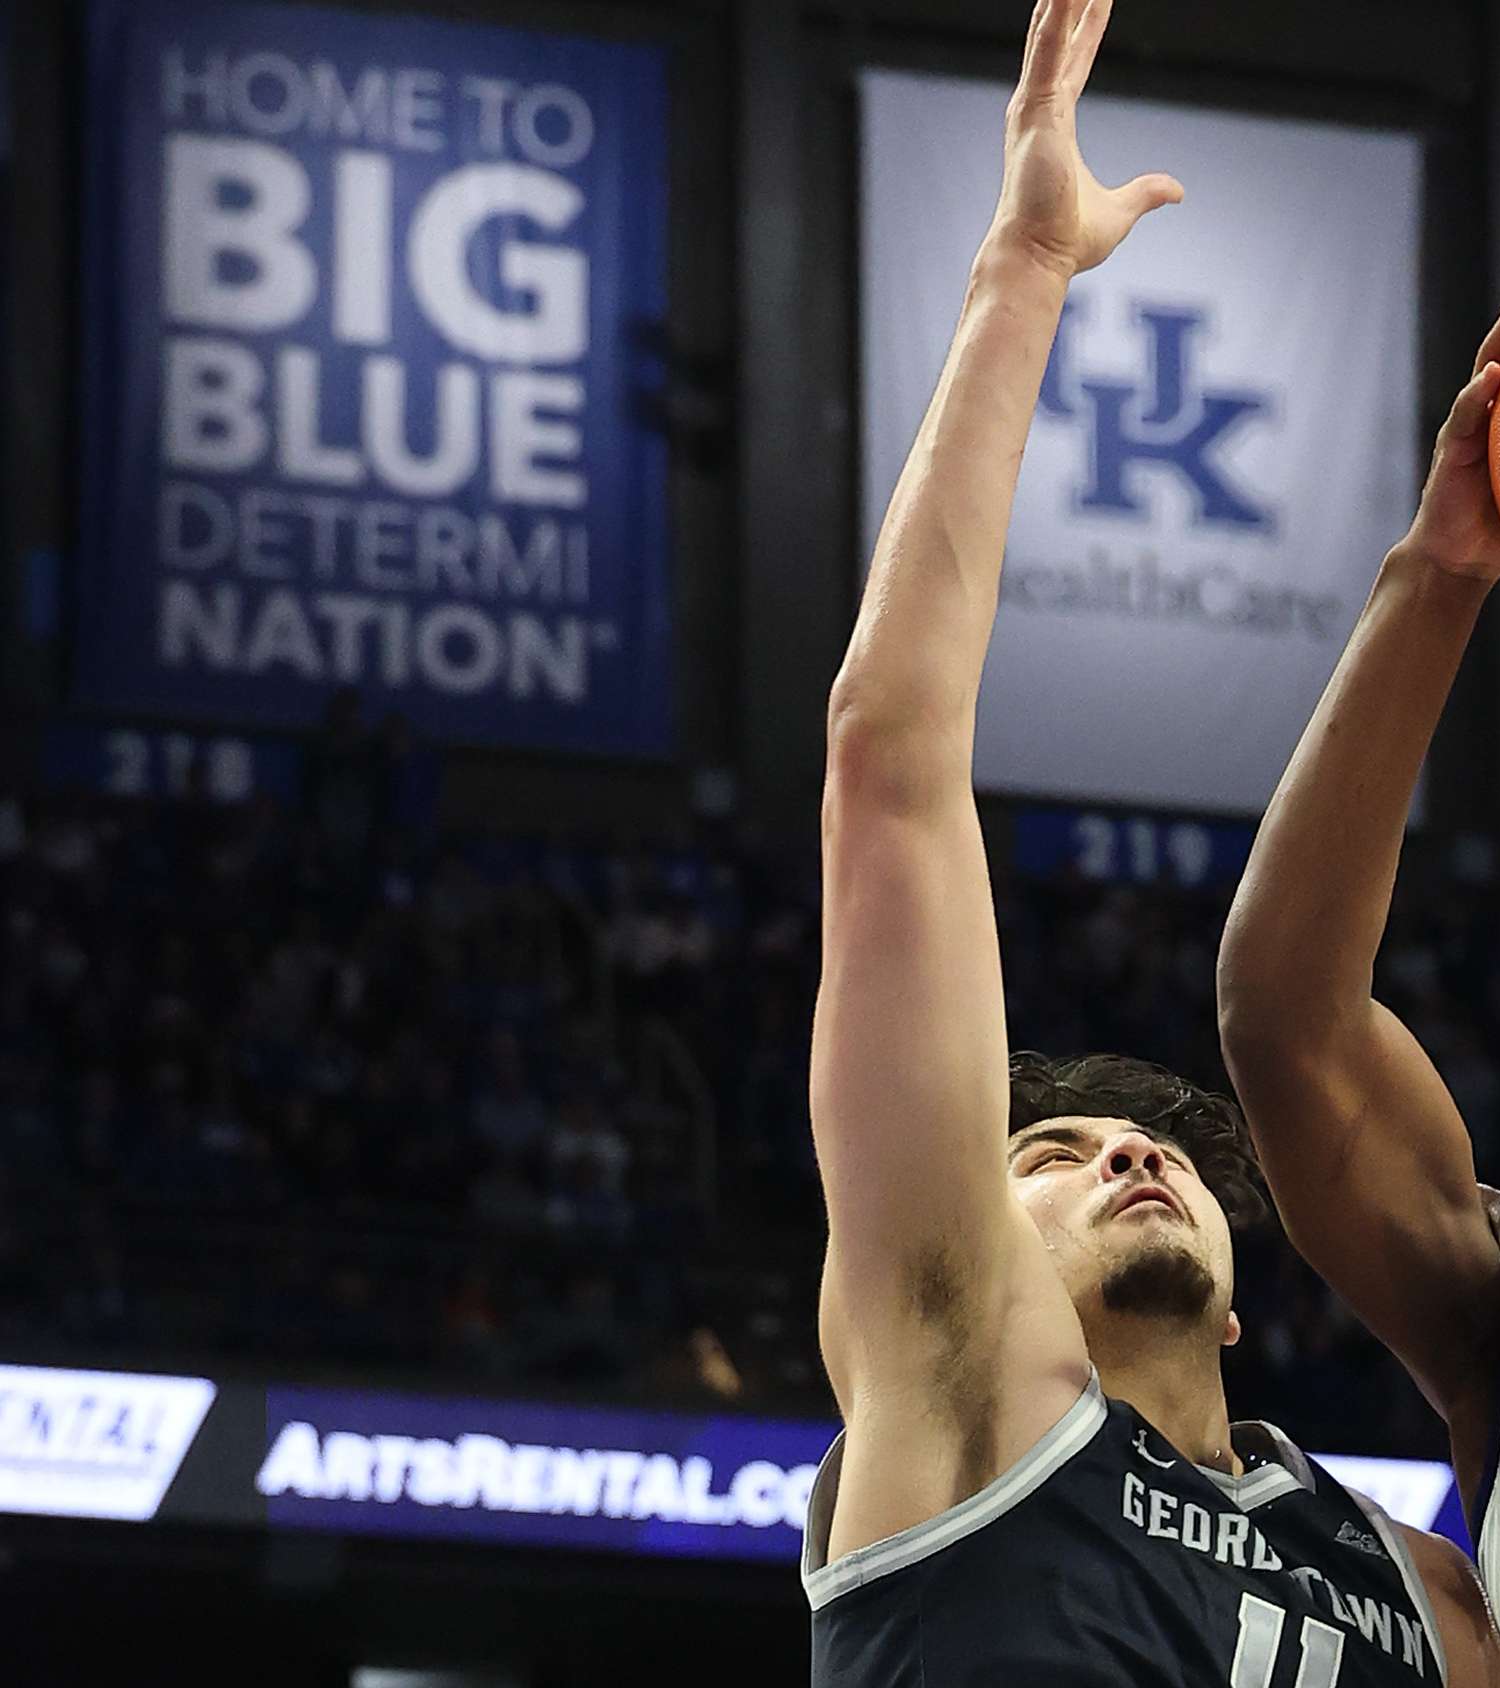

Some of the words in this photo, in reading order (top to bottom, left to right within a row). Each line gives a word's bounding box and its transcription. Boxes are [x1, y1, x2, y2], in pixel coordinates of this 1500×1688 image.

[162, 50, 444, 151] HOME
[459, 78, 594, 167] TO
[163, 134, 589, 366] BIG
[163, 338, 588, 508] BLUE
[1038, 303, 1272, 525] UK
[160, 482, 590, 600] DETERMI
[1001, 547, 1346, 640] ealthCare
[105, 731, 254, 801] 218
[1074, 814, 1212, 885] 219
